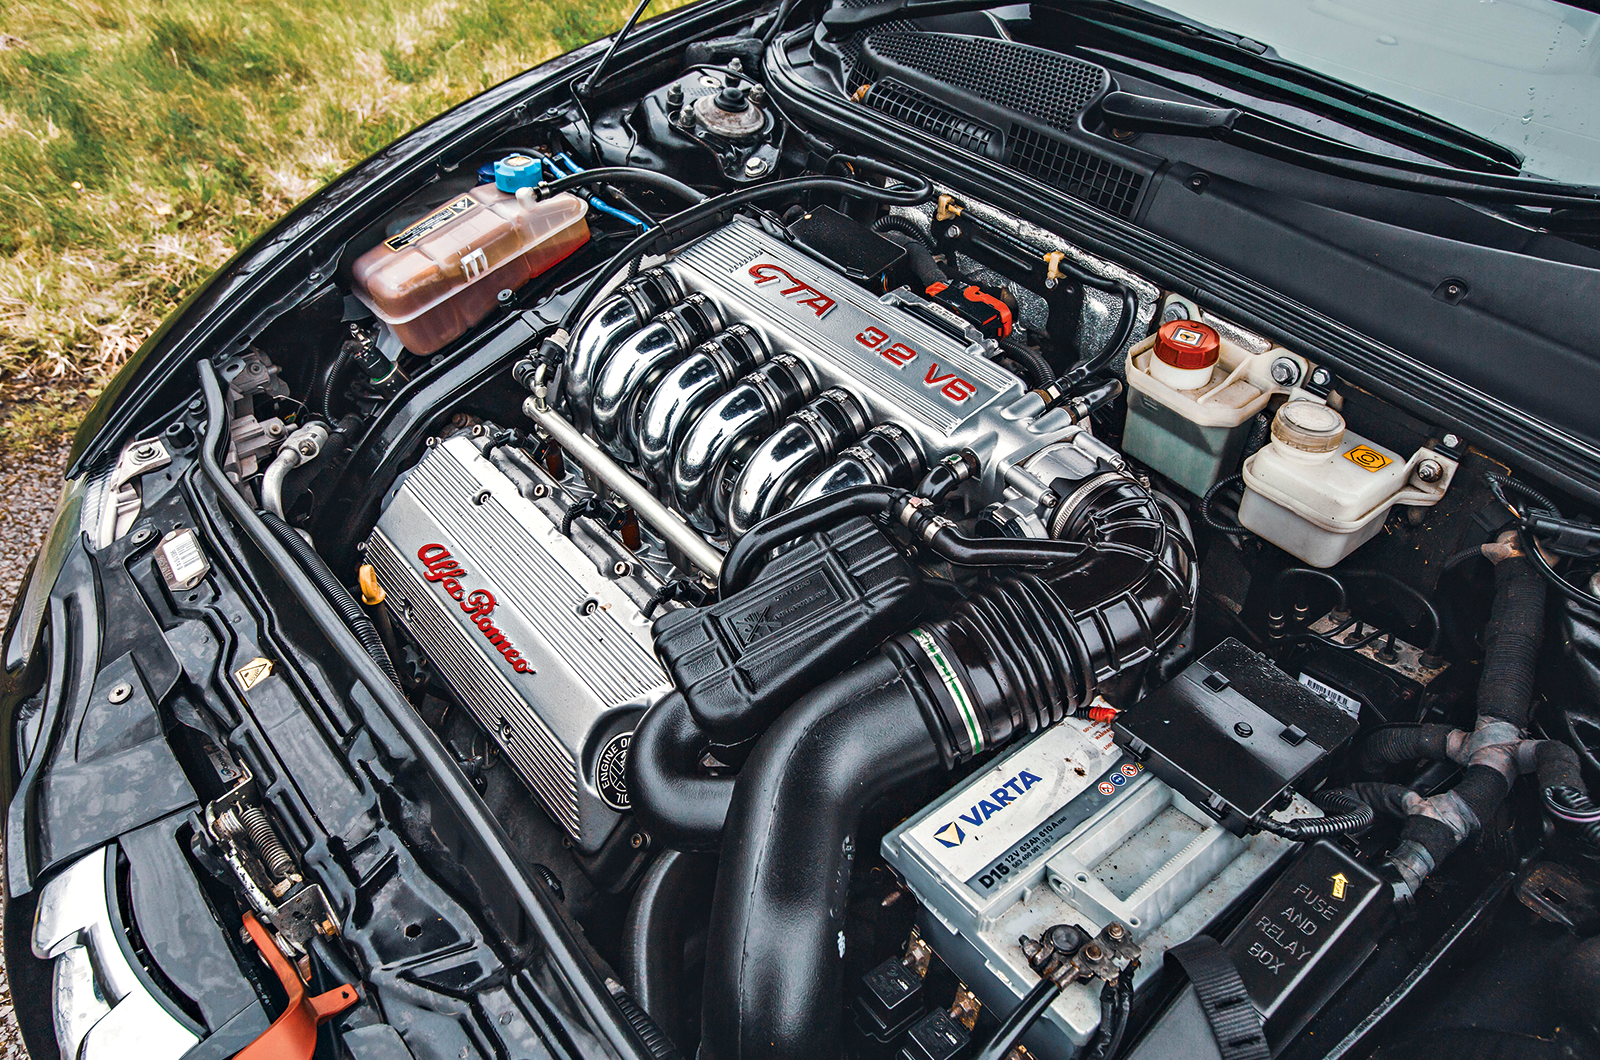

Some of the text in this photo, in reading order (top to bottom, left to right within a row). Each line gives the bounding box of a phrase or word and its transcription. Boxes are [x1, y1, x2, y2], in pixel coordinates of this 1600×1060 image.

[748, 263, 978, 405] GTA 3.2 V6
[417, 542, 536, 674] Alfa Romeo
[600, 737, 631, 790] ENGINE OI
[958, 769, 1043, 827] VARTA
[978, 862, 1011, 890] D15
[1004, 849, 1020, 864] 12V
[1019, 835, 1041, 852] 63Ah
[1281, 906, 1318, 936] AND
[1293, 883, 1339, 921] FUSE
[1247, 941, 1286, 975] BOX
[1255, 915, 1312, 961] RELAY
